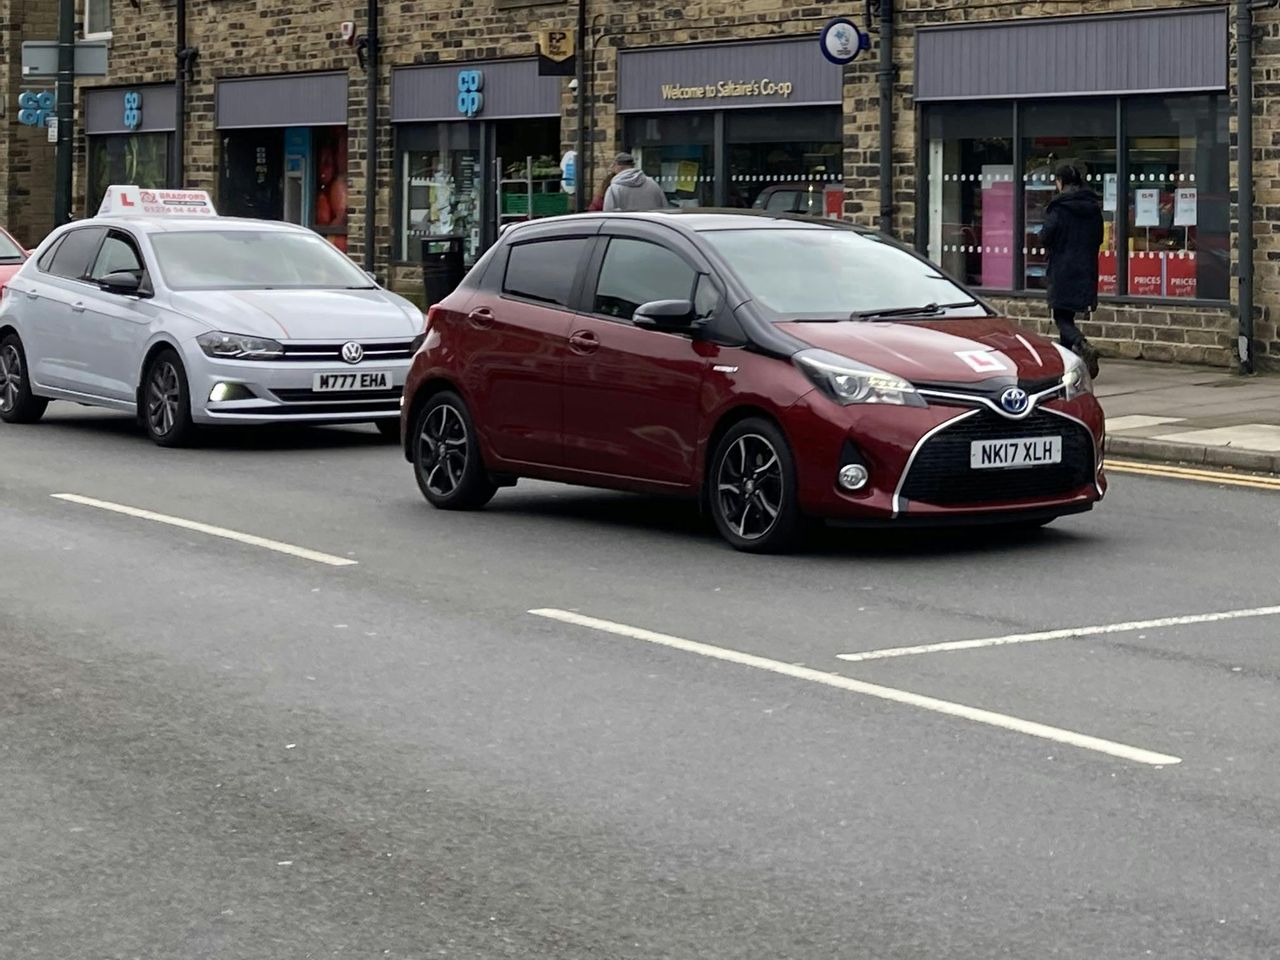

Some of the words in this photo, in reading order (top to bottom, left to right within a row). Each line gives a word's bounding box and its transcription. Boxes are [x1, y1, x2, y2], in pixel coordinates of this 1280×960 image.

[662, 83, 704, 100] Welcome
[705, 84, 716, 98] to
[717, 80, 759, 97] Saltaire's
[760, 79, 793, 98] Co-op
[120, 193, 135, 206] L
[159, 193, 206, 201] BRADFORD
[1134, 275, 1161, 285] PRICES
[968, 354, 995, 367] L
[320, 373, 357, 389] M777
[360, 373, 387, 388] EHA
[981, 443, 1019, 464] NK17
[1023, 441, 1052, 462] XLH
